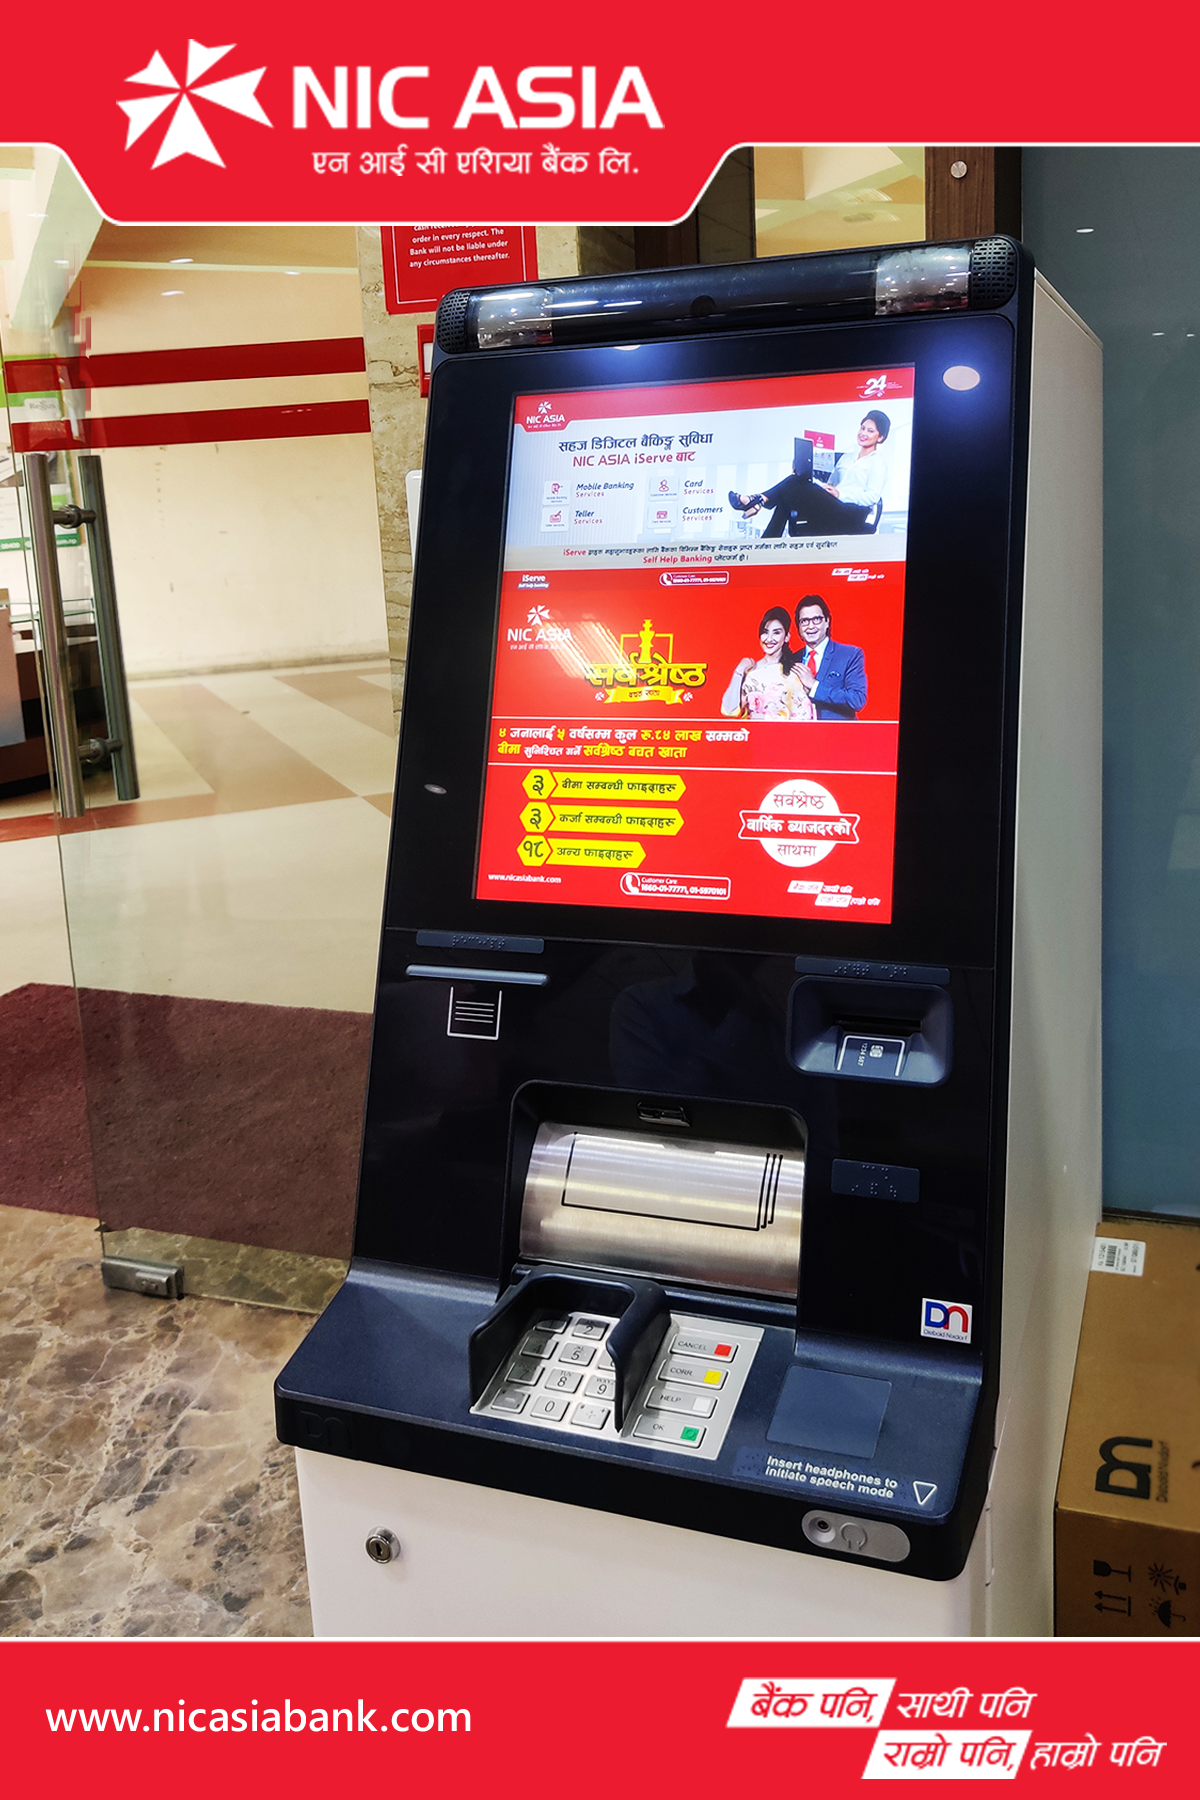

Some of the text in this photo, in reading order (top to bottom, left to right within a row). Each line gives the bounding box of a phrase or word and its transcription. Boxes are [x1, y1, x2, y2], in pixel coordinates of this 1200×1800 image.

[412, 235, 431, 243] order
[462, 229, 489, 239] respect.
[491, 228, 504, 236] The
[429, 245, 441, 254] will
[466, 242, 486, 250] liable
[487, 240, 508, 248] under
[424, 256, 472, 266] circumstances
[473, 252, 510, 262] thereafter.
[864, 375, 886, 394] 24
[526, 414, 565, 424] NIC ASIA
[558, 440, 587, 452] सहज
[591, 436, 637, 450] डिजिटल
[678, 431, 713, 447] सुविधा
[573, 450, 696, 467] NIC ASIA iServe बाट
[576, 482, 634, 491] Mobile Banking
[682, 514, 712, 522] Services
[660, 556, 678, 564] Help
[680, 555, 712, 564] Banking
[522, 574, 546, 582] iServe
[507, 628, 574, 642] NIC ASIA
[510, 725, 556, 740] जनालाई
[569, 726, 612, 739] वर्षसम्म
[614, 729, 638, 744] कुल
[674, 730, 702, 742] लाख
[705, 728, 750, 742] सम्मको
[628, 746, 655, 758] बचत
[658, 747, 688, 758] खाता
[532, 775, 544, 796] ३
[530, 808, 541, 829] ३
[746, 815, 851, 836] वार्षिक ब्याजदरको
[777, 844, 817, 857] साथमा
[583, 1325, 593, 1335] 2
[924, 1329, 967, 1340] Diebold Nixdorf
[678, 1341, 707, 1351] CANCEL
[571, 1350, 580, 1360] 5
[670, 1367, 693, 1376] CORR
[557, 1377, 567, 1387] 8
[597, 1384, 607, 1395] 9
[660, 1394, 682, 1402] HELP
[767, 1456, 898, 1489] Insert headphones to
[765, 1466, 894, 1498] initiate speech mode
